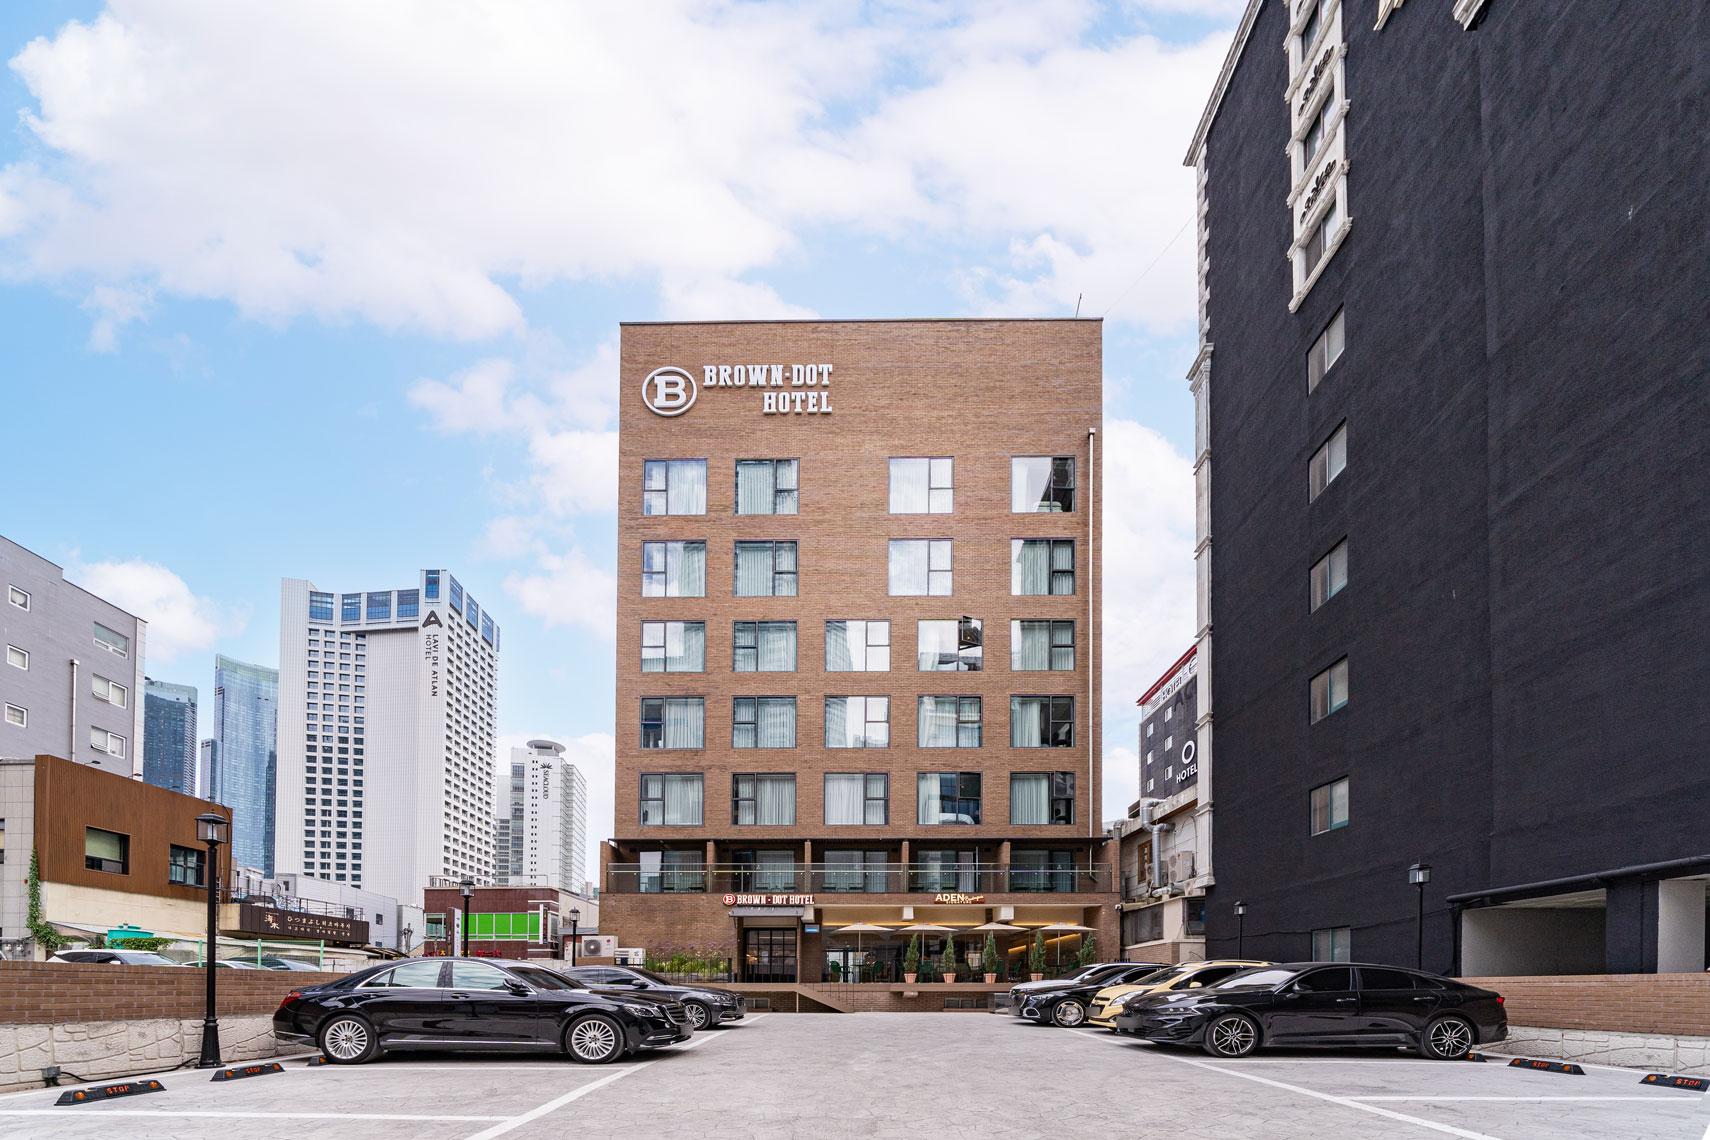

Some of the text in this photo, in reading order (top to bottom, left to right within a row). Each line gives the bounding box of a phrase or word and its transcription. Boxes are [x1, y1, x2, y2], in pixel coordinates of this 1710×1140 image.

[763, 391, 833, 414] HOTEL
[432, 656, 438, 666] DE
[1176, 763, 1198, 783] HOTEL
[789, 894, 815, 905] HOTEL
[935, 893, 965, 902] ADEN
